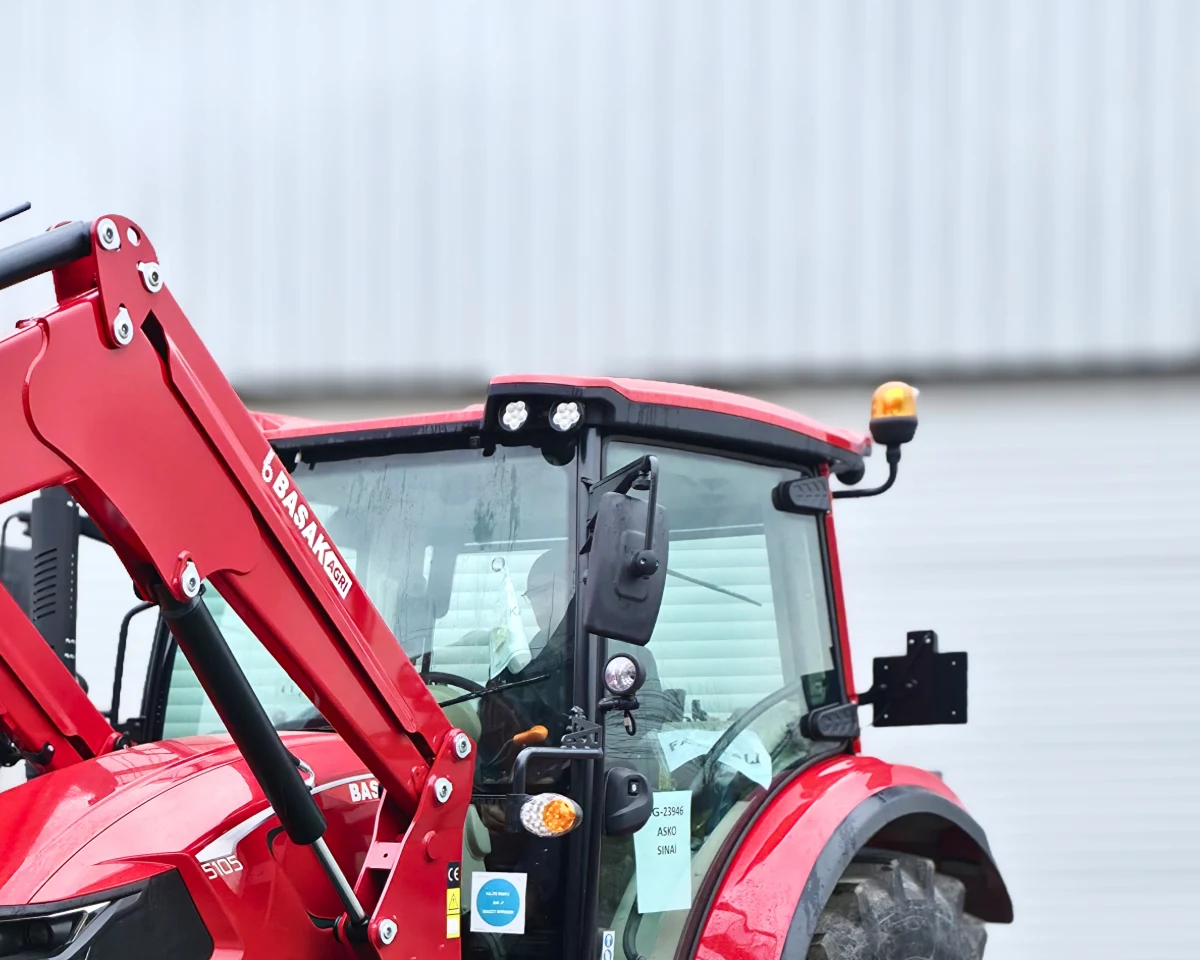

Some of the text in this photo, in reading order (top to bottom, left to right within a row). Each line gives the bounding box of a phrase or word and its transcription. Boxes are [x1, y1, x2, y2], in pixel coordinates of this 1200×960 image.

[326, 559, 350, 593] AGRI
[349, 780, 379, 802] BAS
[651, 806, 684, 817] G-23946
[657, 826, 677, 836] ASKO
[201, 855, 243, 880] 5105
